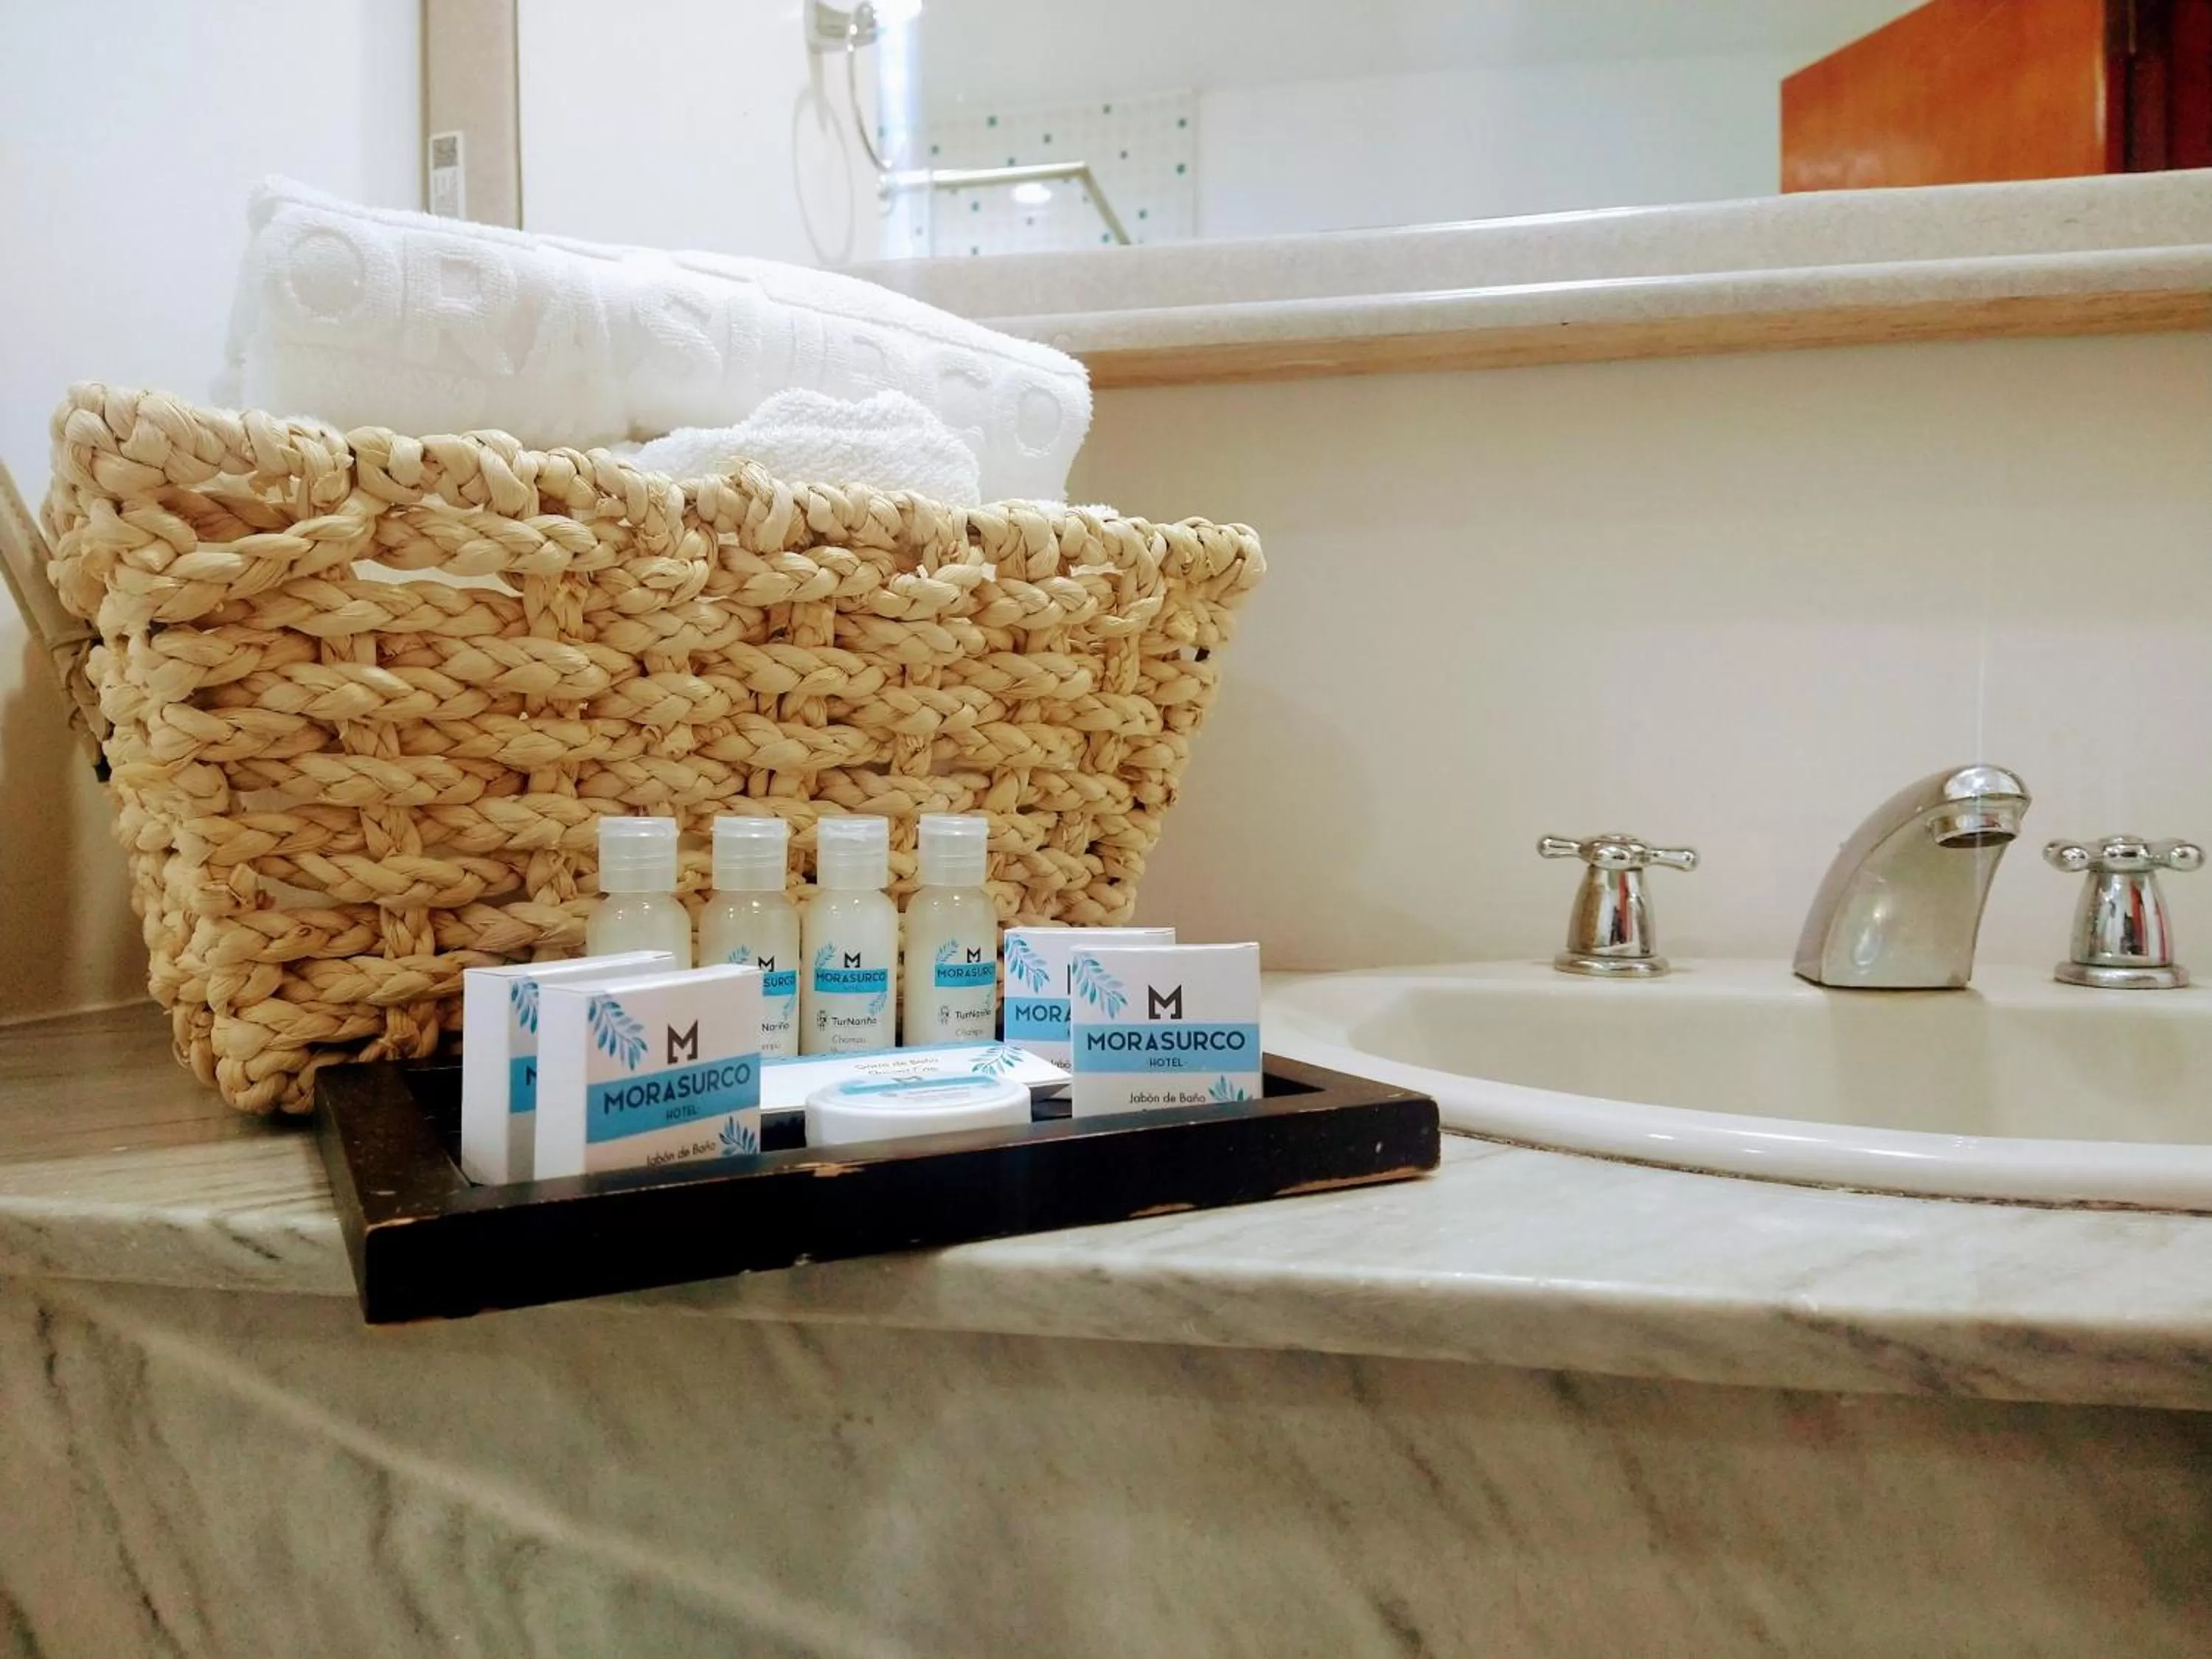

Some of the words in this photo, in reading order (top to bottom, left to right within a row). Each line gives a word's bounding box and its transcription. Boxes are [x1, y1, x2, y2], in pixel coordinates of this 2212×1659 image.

[844, 952, 860, 968] M
[967, 946, 981, 964] M
[757, 956, 774, 973] M
[816, 972, 886, 984] MORASURCO
[1148, 984, 1182, 1020] M
[667, 1018, 698, 1065] M
[1088, 1031, 1245, 1051] MORASURCO
[1150, 1057, 1183, 1068] HOTEL
[604, 1062, 751, 1115] MORASURCO
[1130, 1091, 1159, 1104] Jabón
[1164, 1092, 1175, 1103] de
[1180, 1092, 1206, 1103] Baño
[666, 1105, 698, 1121] HOTEL
[678, 1145, 690, 1159] de
